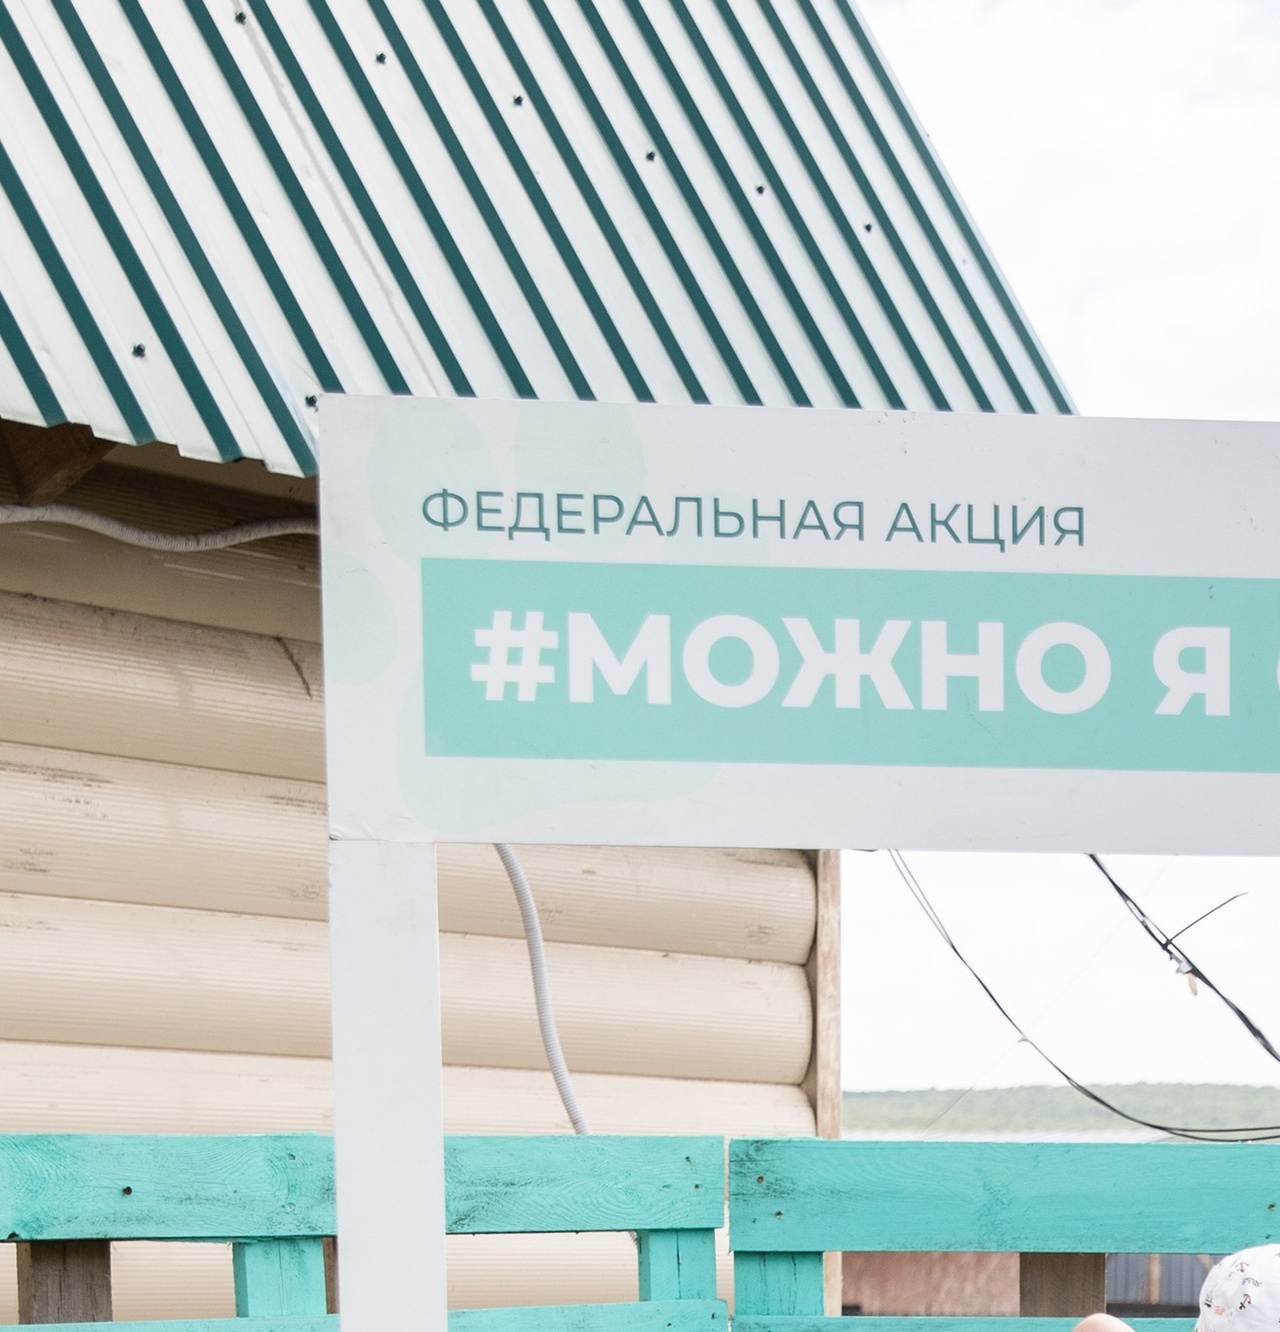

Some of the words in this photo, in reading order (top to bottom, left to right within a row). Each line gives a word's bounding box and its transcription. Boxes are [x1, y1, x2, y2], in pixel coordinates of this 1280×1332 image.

[421, 488, 865, 542] ФЕДЕРАЛЬНАЯ
[885, 502, 1087, 554] АКЦИЯ
[470, 610, 1112, 715] #МОЖНО
[1152, 625, 1231, 717] Я
